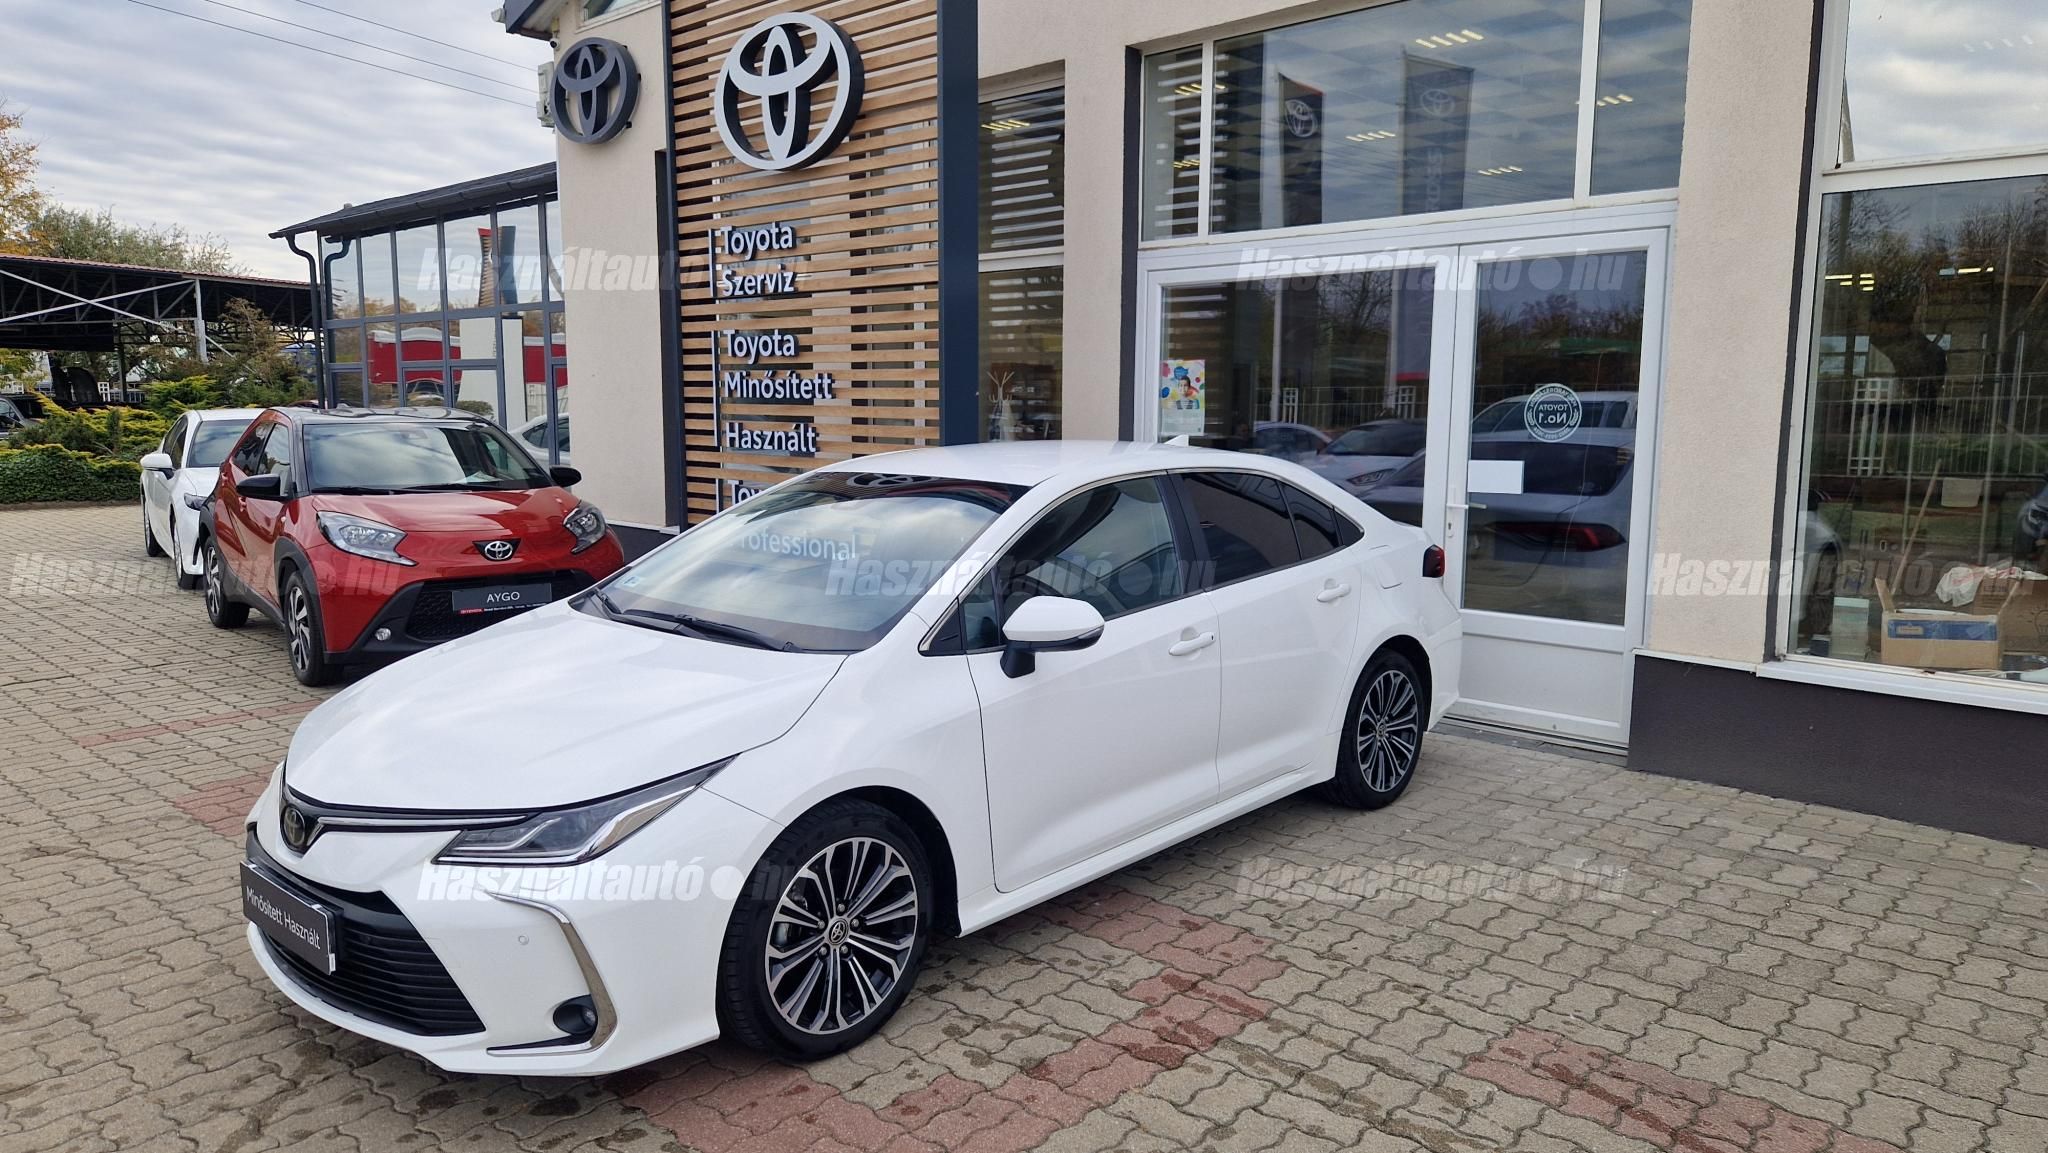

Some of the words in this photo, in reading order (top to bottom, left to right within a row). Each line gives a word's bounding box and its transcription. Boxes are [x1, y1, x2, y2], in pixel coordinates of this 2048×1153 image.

[720, 222, 793, 260] Toyota
[722, 264, 794, 296] Szerviz
[723, 329, 795, 364] Toyota
[724, 370, 832, 399] Minősített
[725, 422, 816, 452] Használt
[487, 591, 520, 603] AYGO
[284, 911, 321, 950] Használt
